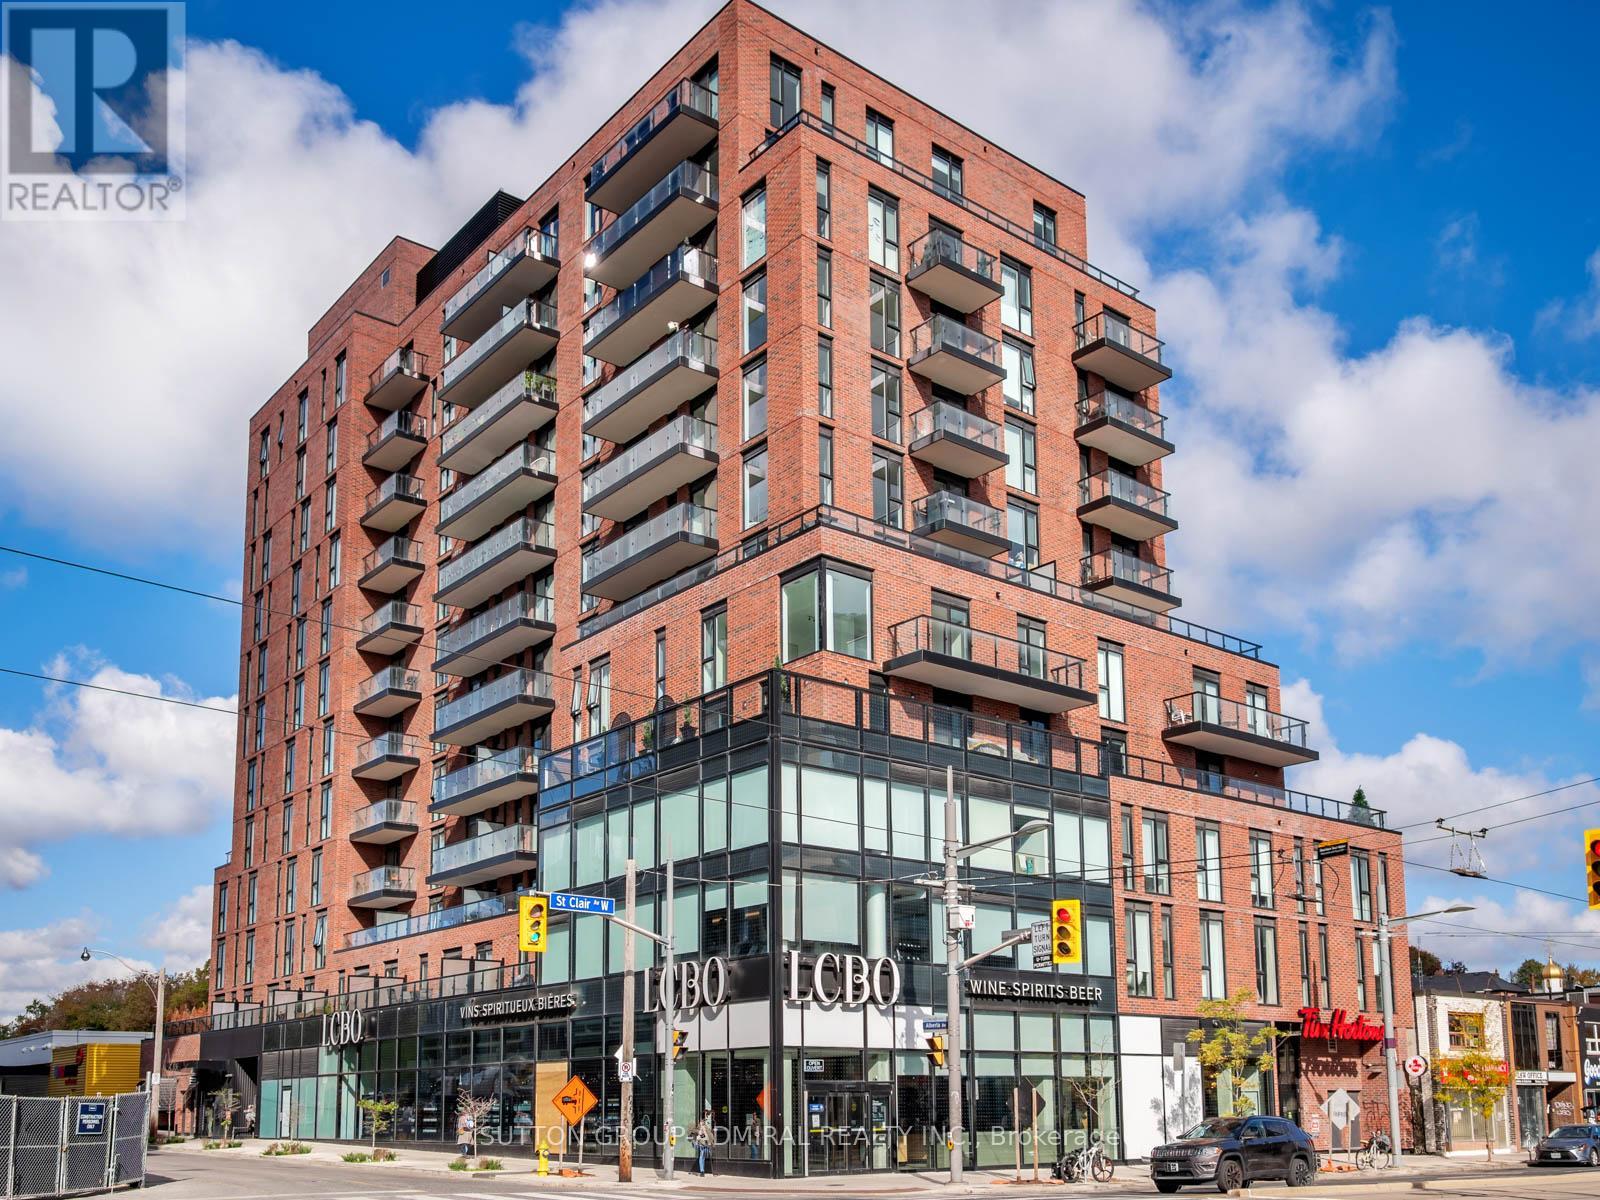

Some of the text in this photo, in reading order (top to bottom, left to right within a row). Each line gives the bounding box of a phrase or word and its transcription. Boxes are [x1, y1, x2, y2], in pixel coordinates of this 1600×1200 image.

[556, 895, 566, 907] St
[569, 897, 591, 909] Clair
[601, 900, 609, 911] W
[1034, 923, 1050, 933] LEFT
[1034, 933, 1050, 943] TURN
[643, 956, 725, 1013] LCBO
[788, 950, 901, 1006] LCBO
[970, 980, 1103, 1001] WINE SPIRITS BEER
[460, 1004, 481, 1019] VINS
[482, 998, 535, 1017] SPIRITUEUX
[321, 1008, 362, 1046] LCBO
[1298, 1007, 1330, 1039] Tim
